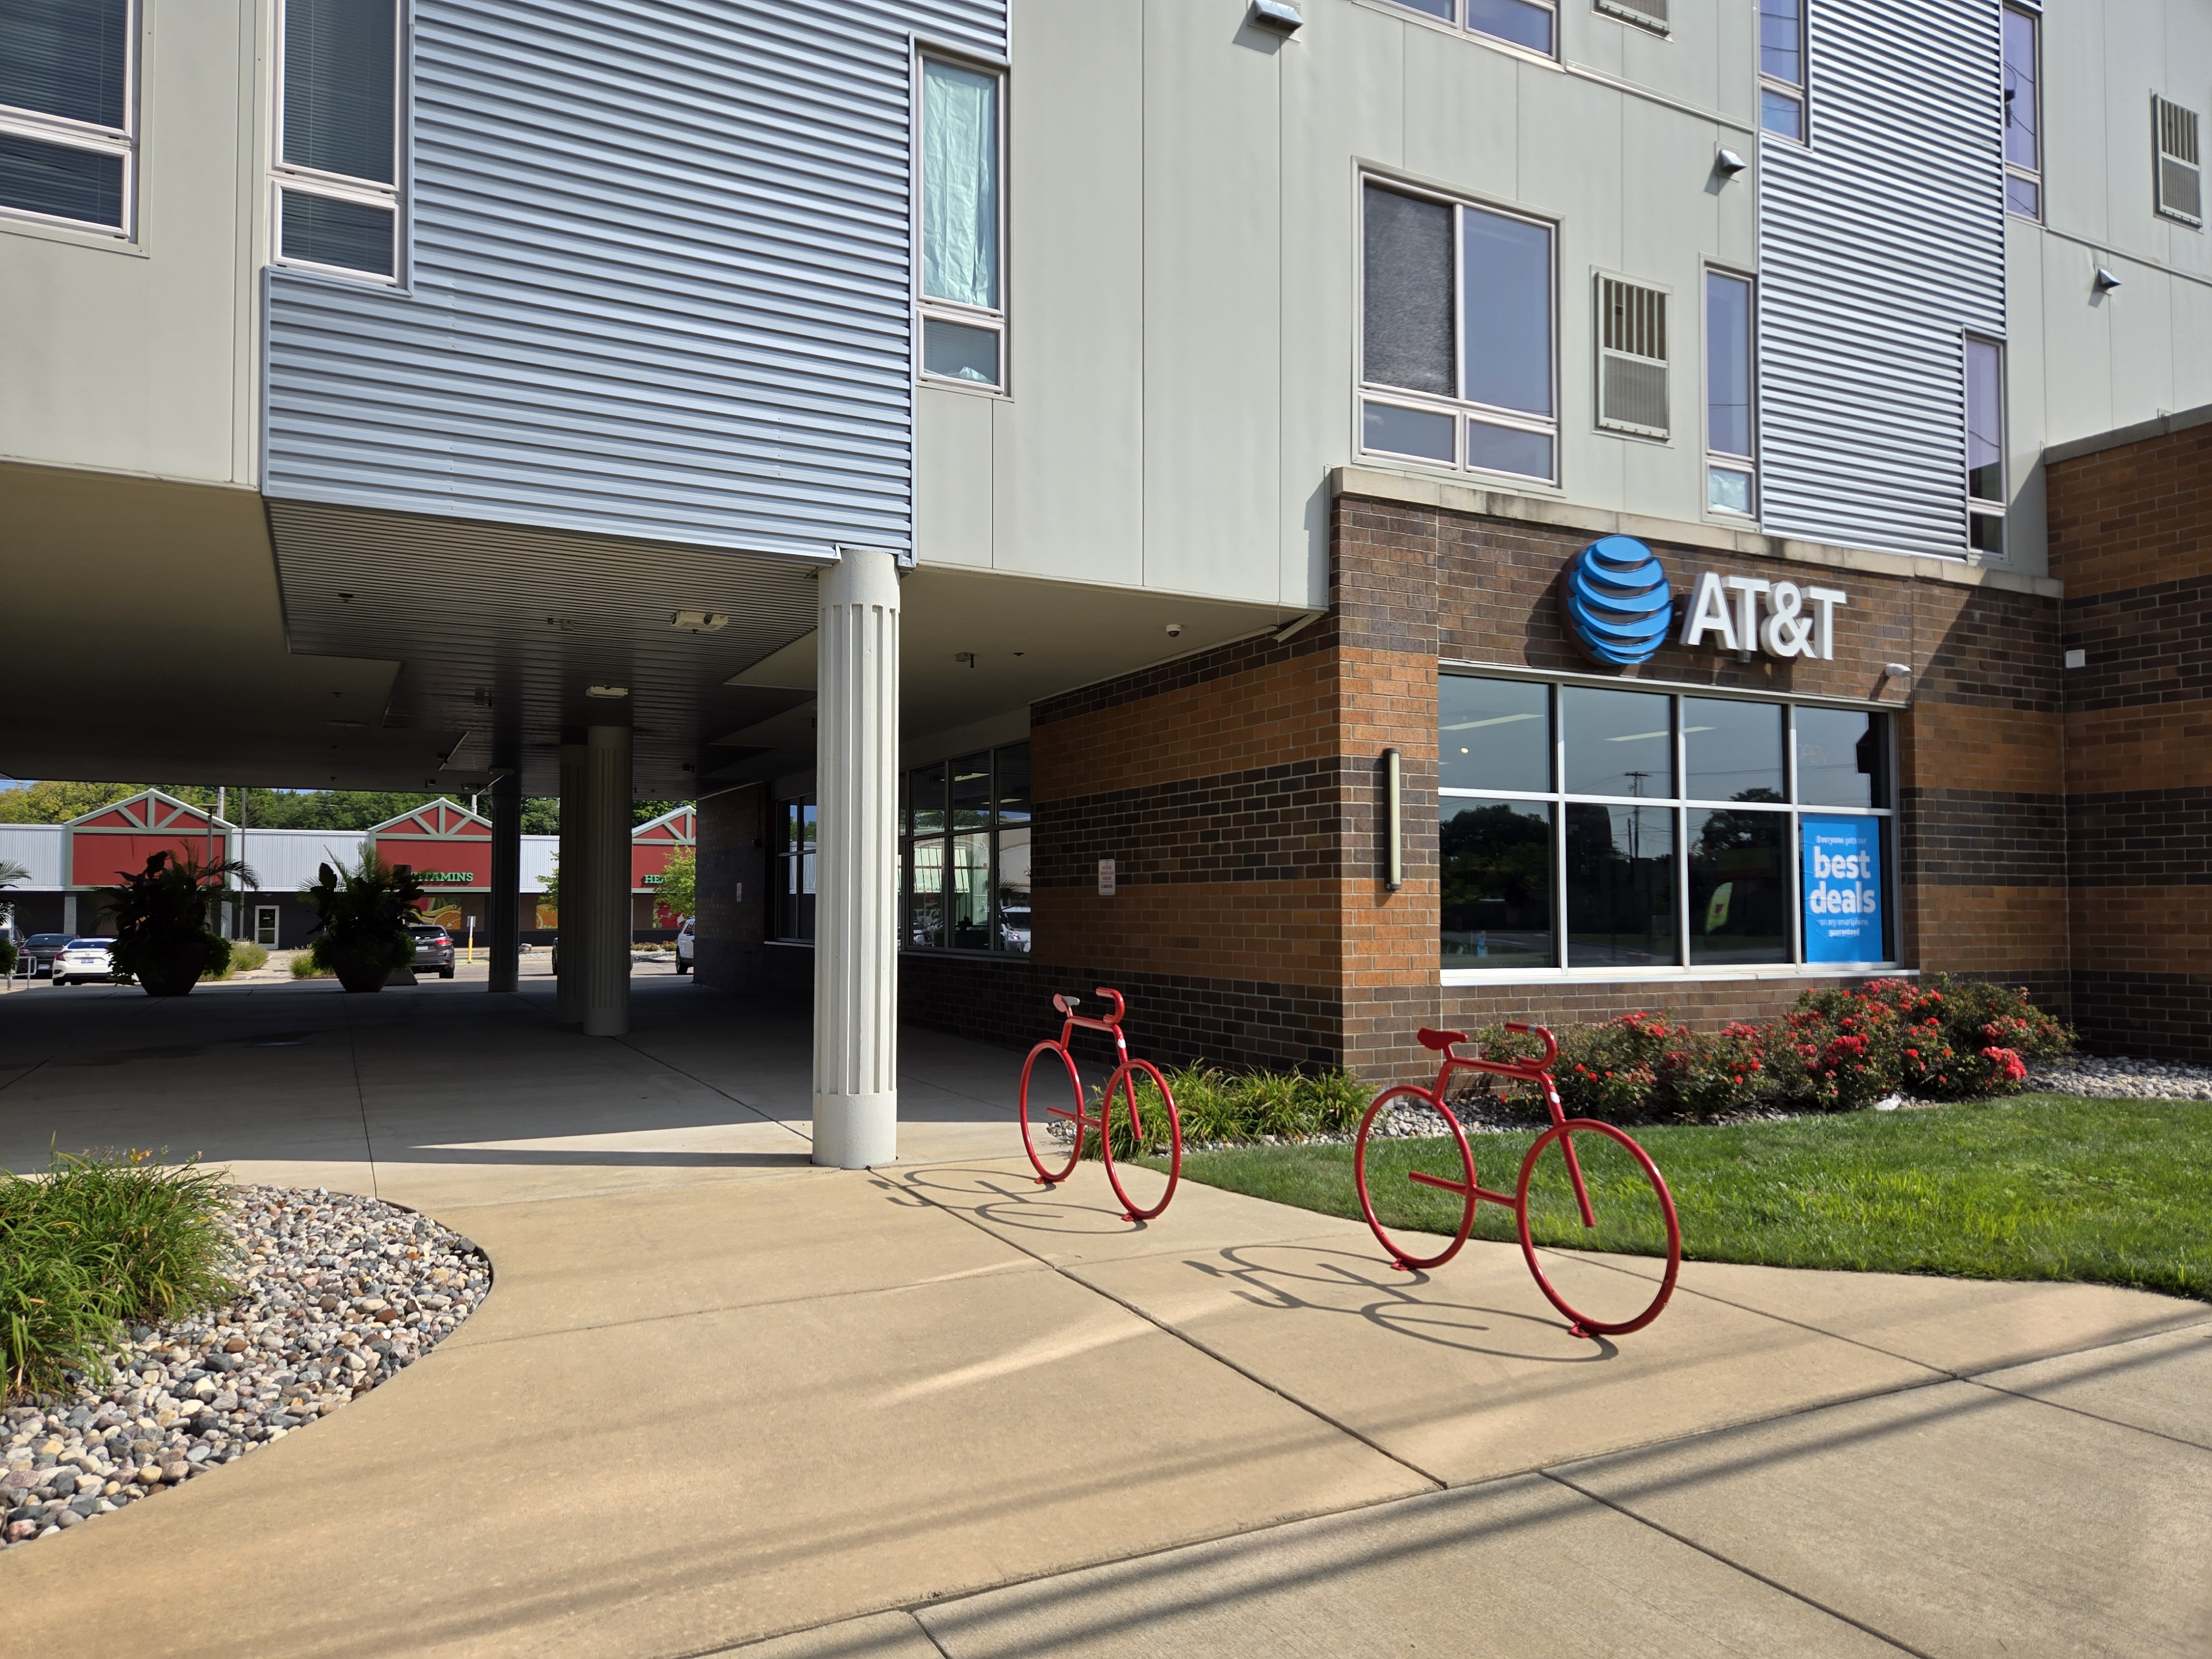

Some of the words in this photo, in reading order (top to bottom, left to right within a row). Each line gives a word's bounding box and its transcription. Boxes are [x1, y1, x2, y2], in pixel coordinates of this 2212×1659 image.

[1679, 571, 1848, 660] AT&T
[1816, 836, 1844, 846] Everyone
[1845, 837, 1857, 847] gets
[1813, 846, 1871, 879] best
[1810, 880, 1876, 914] deals
[1829, 928, 1860, 937] guaranteed
